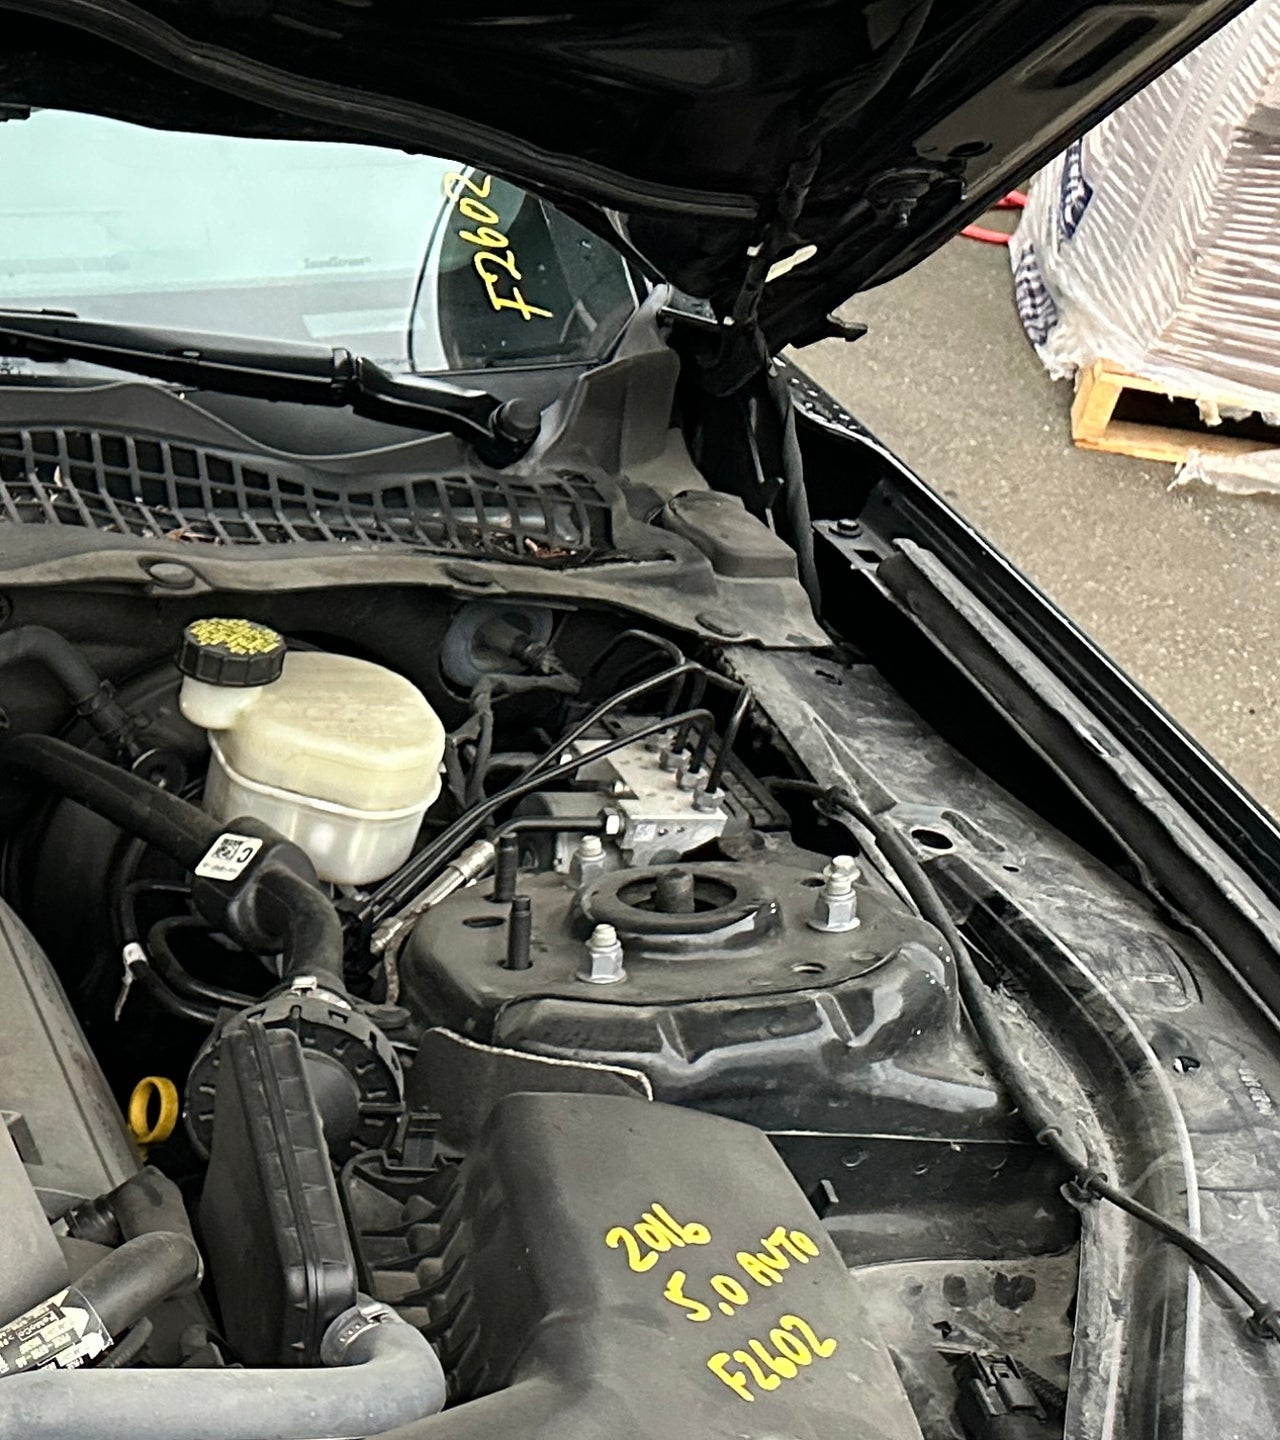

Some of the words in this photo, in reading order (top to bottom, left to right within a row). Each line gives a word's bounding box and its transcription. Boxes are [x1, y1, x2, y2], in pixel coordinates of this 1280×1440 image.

[444, 172, 554, 320] F2602
[606, 1203, 711, 1272] 2016
[664, 1271, 749, 1321] 5.0
[736, 1226, 820, 1287] AUTO
[707, 1315, 837, 1401] F2602
